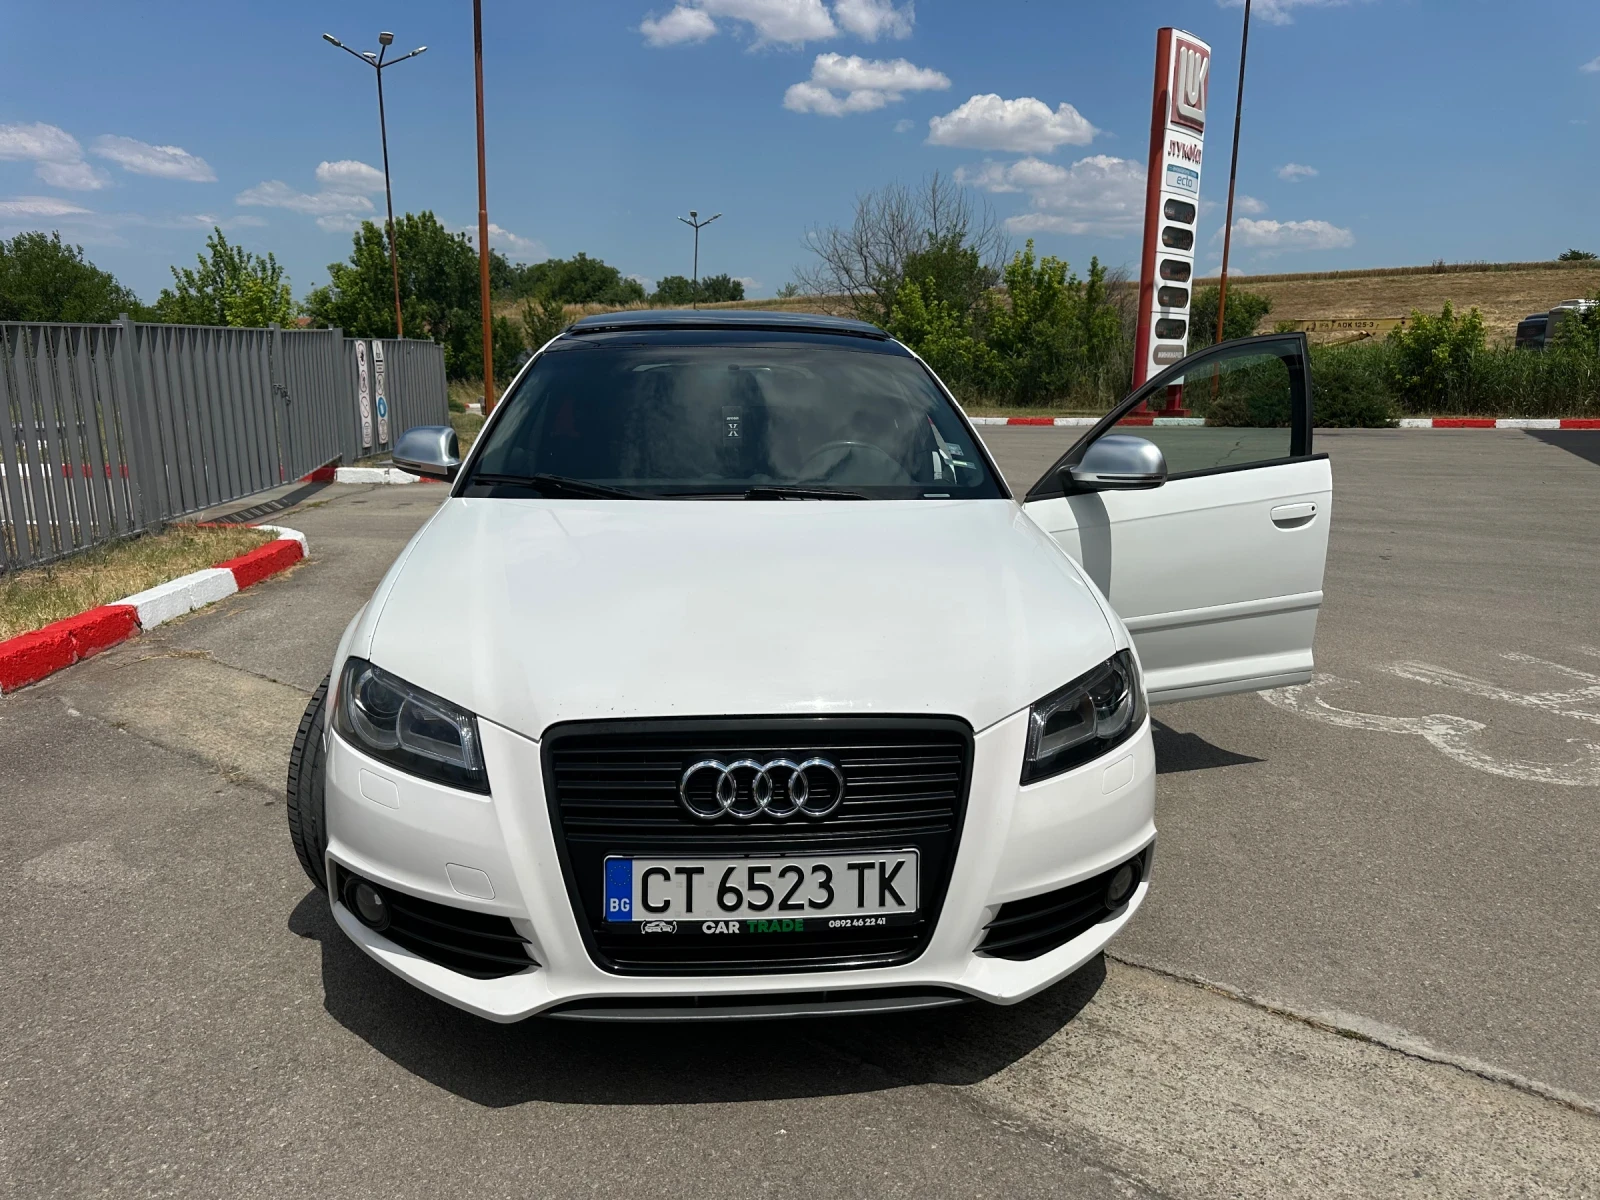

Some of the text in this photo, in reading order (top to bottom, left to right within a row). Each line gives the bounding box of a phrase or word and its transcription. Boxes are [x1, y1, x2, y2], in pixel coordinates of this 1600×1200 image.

[1177, 176, 1192, 187] ecto
[641, 859, 907, 913] CT 6523 TK
[609, 898, 630, 912] BG
[702, 919, 804, 934] CAR TRADE
[828, 917, 886, 928] 0892 46 22 41
